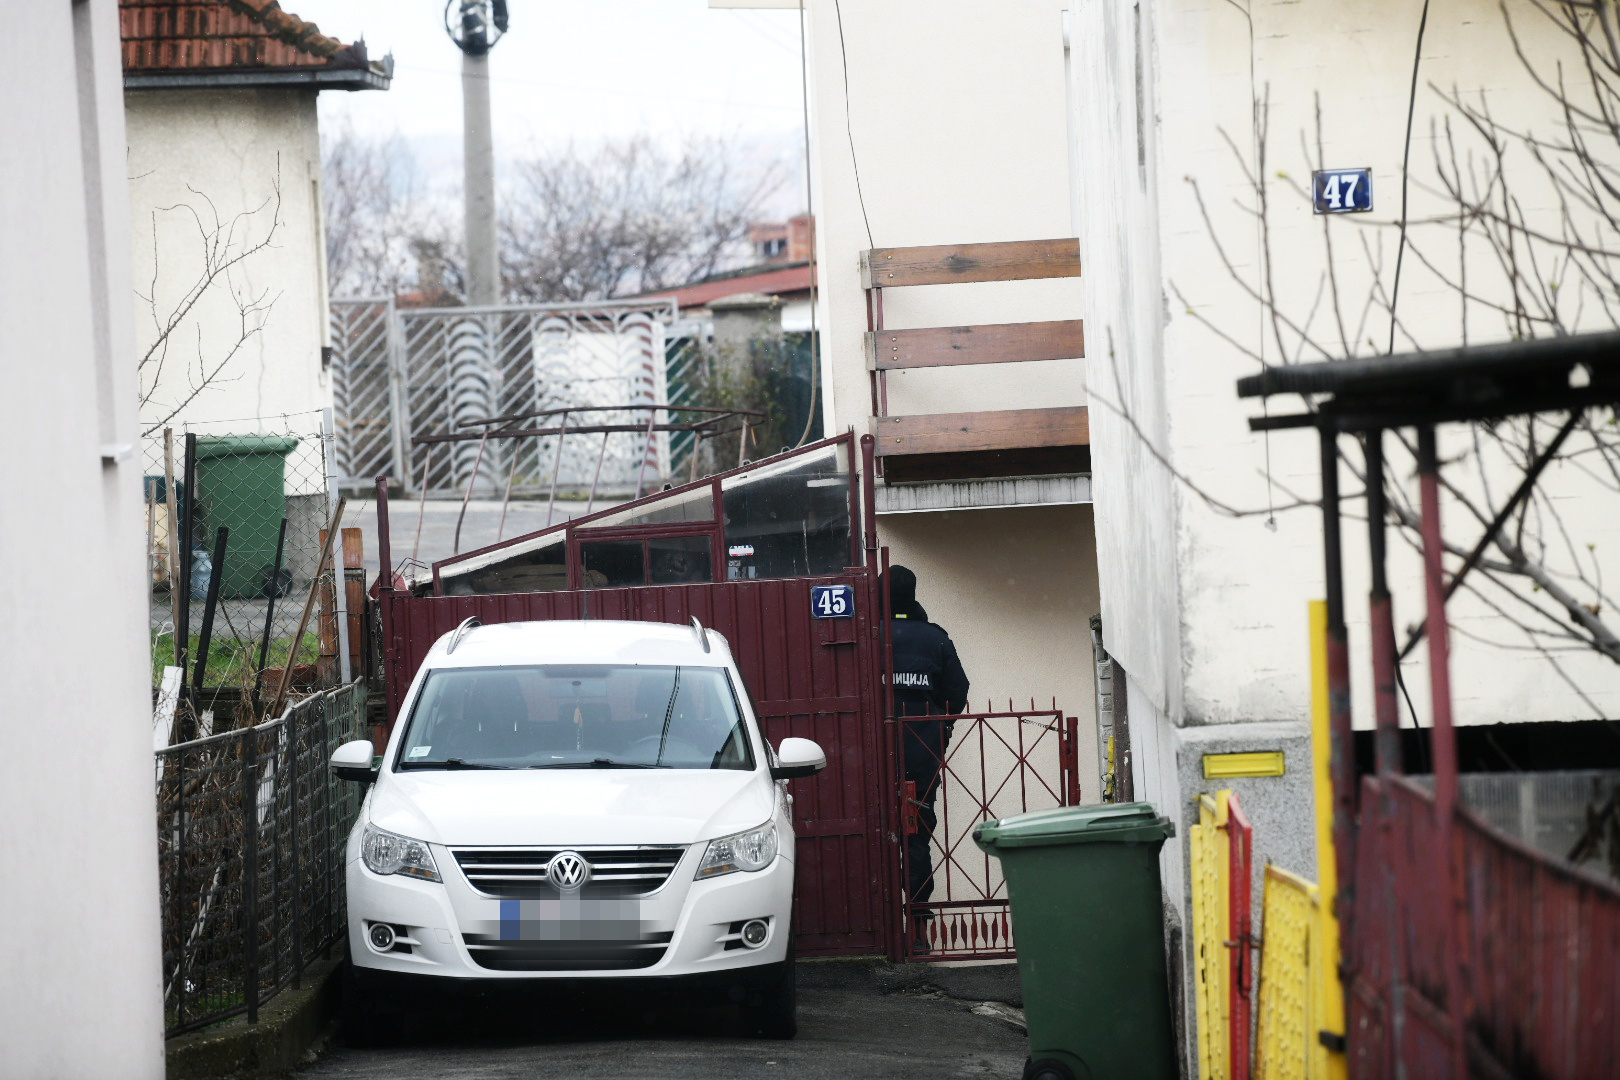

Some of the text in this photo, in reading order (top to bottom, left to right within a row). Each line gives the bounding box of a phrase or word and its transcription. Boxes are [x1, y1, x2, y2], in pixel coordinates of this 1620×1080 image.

[1323, 174, 1360, 208] 47
[818, 589, 846, 614] 45
[550, 853, 587, 889] VW
